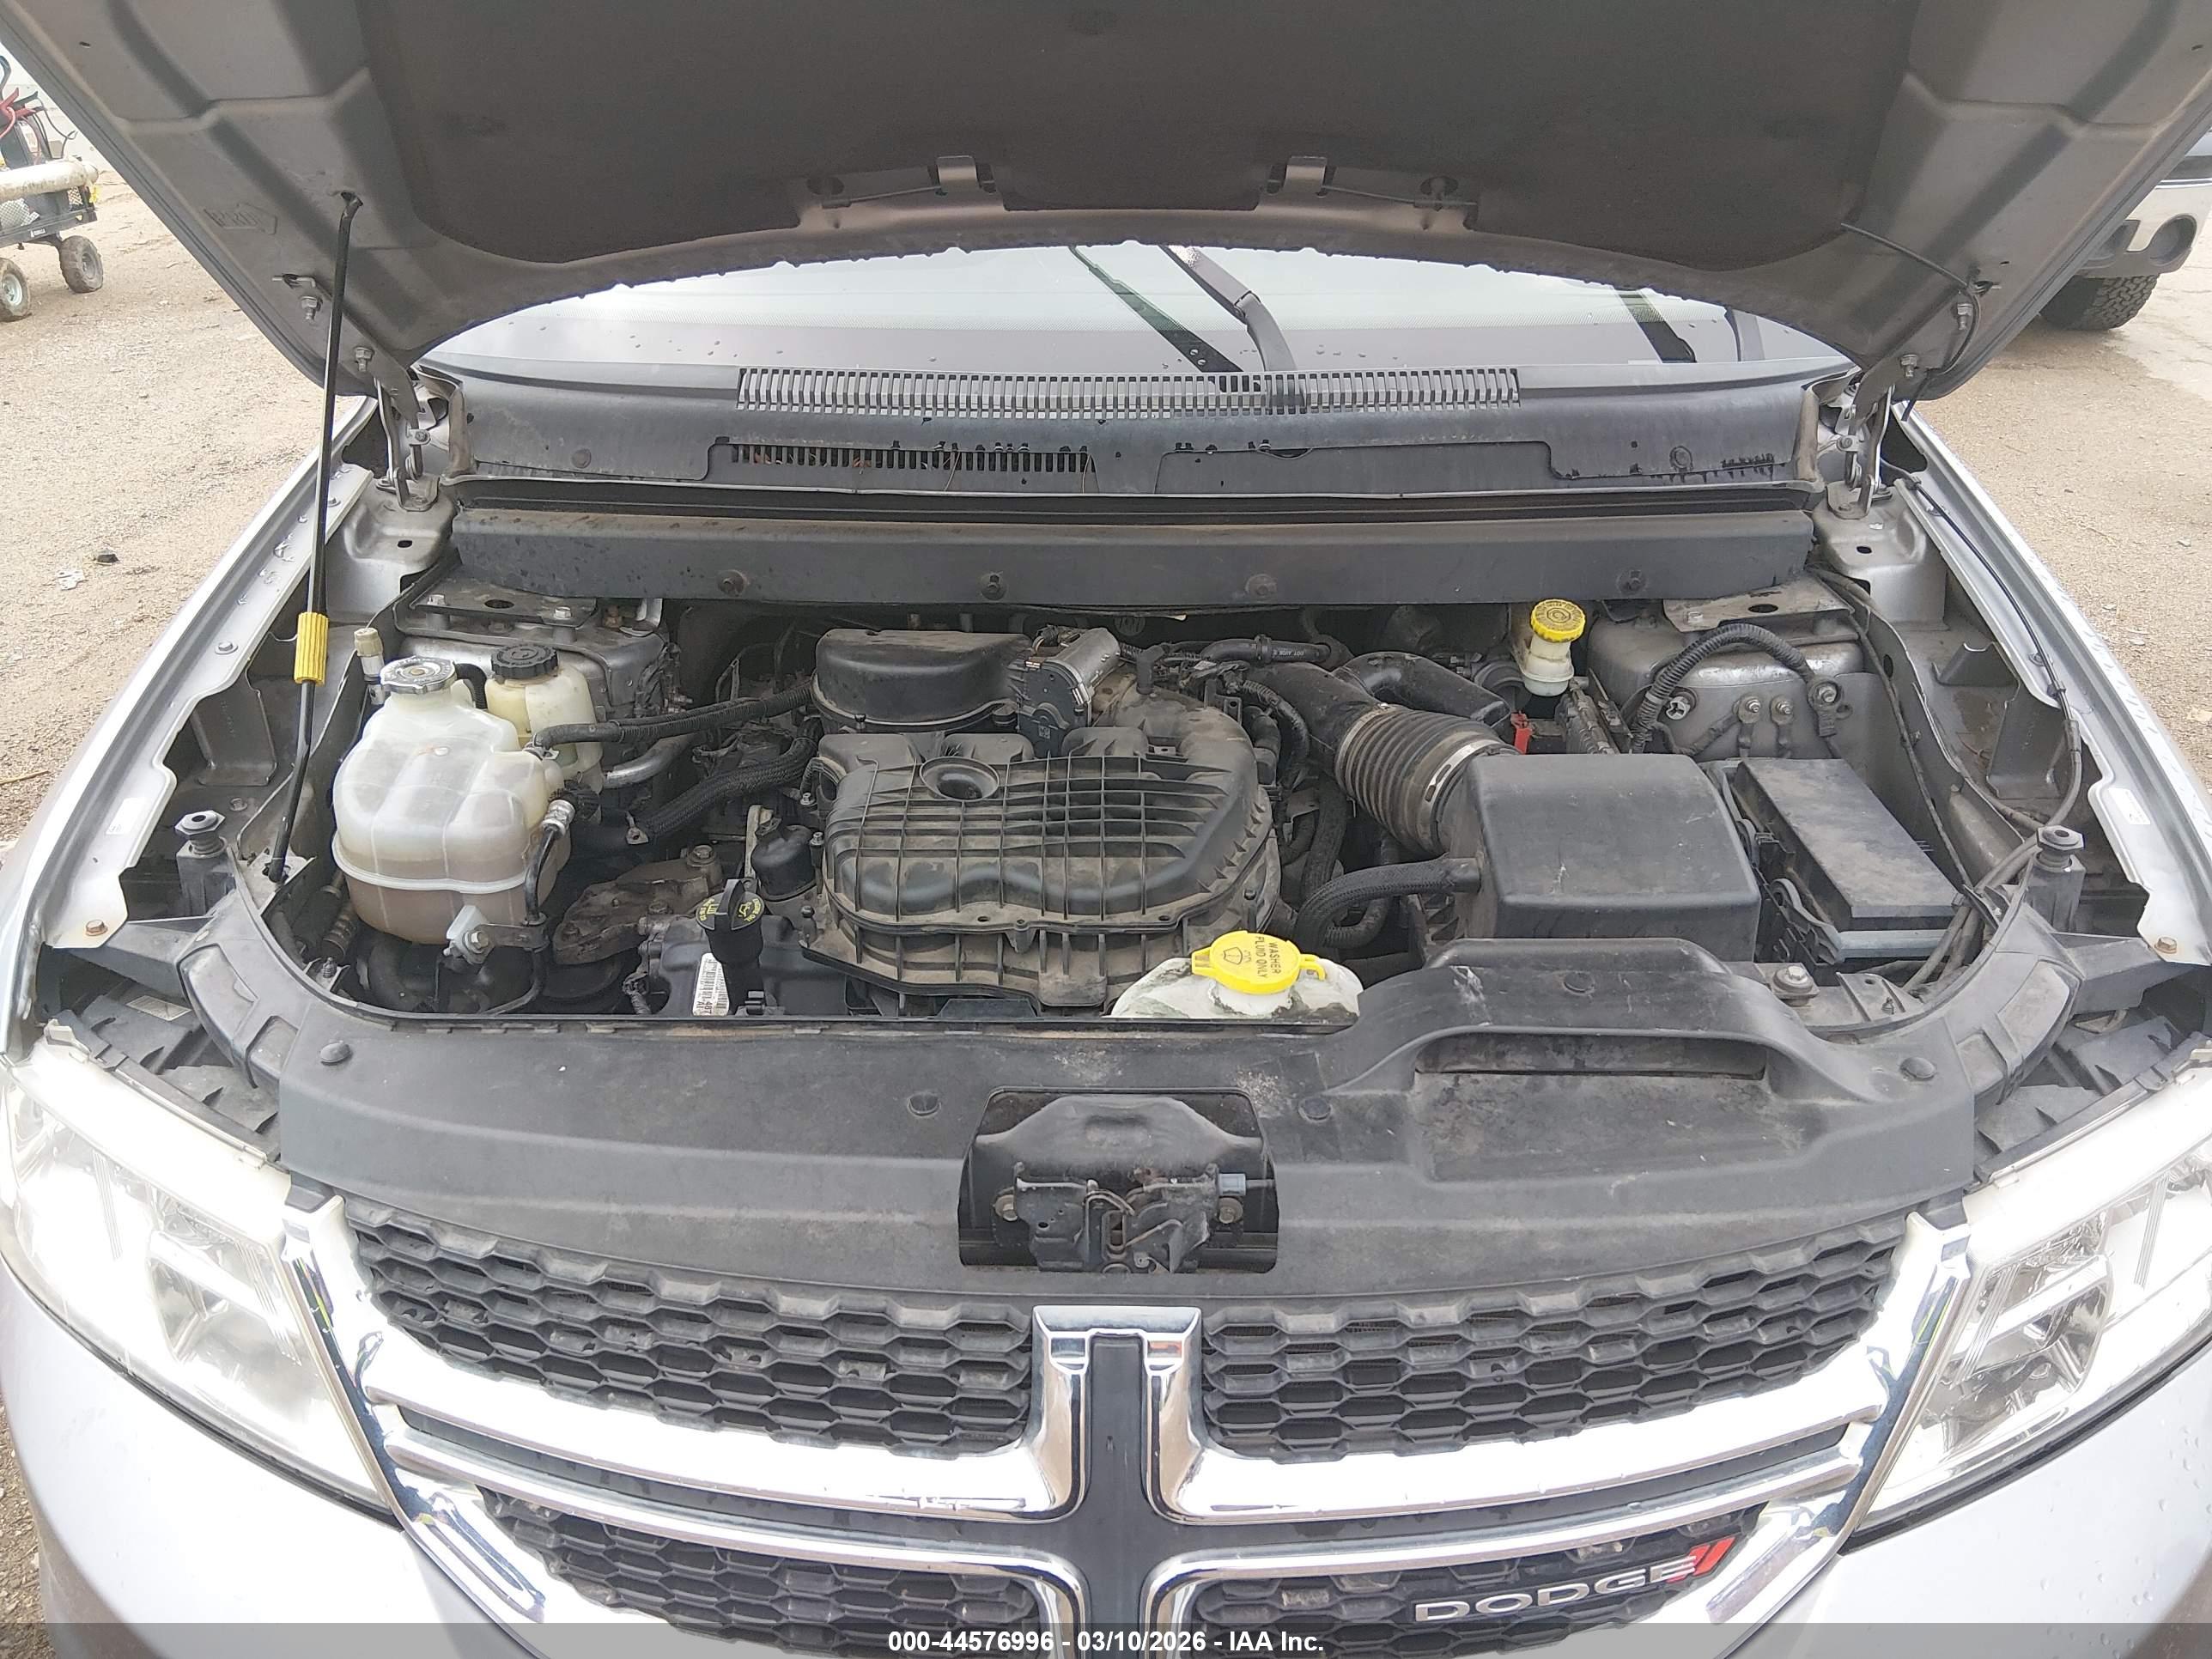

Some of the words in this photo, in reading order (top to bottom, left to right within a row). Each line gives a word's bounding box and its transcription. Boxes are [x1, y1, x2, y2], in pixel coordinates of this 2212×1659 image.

[1255, 936, 1267, 957] FLUID
[1268, 942, 1282, 974] WASHER
[1256, 957, 1268, 979] ONLY
[1414, 1554, 1697, 1622] DODGE
